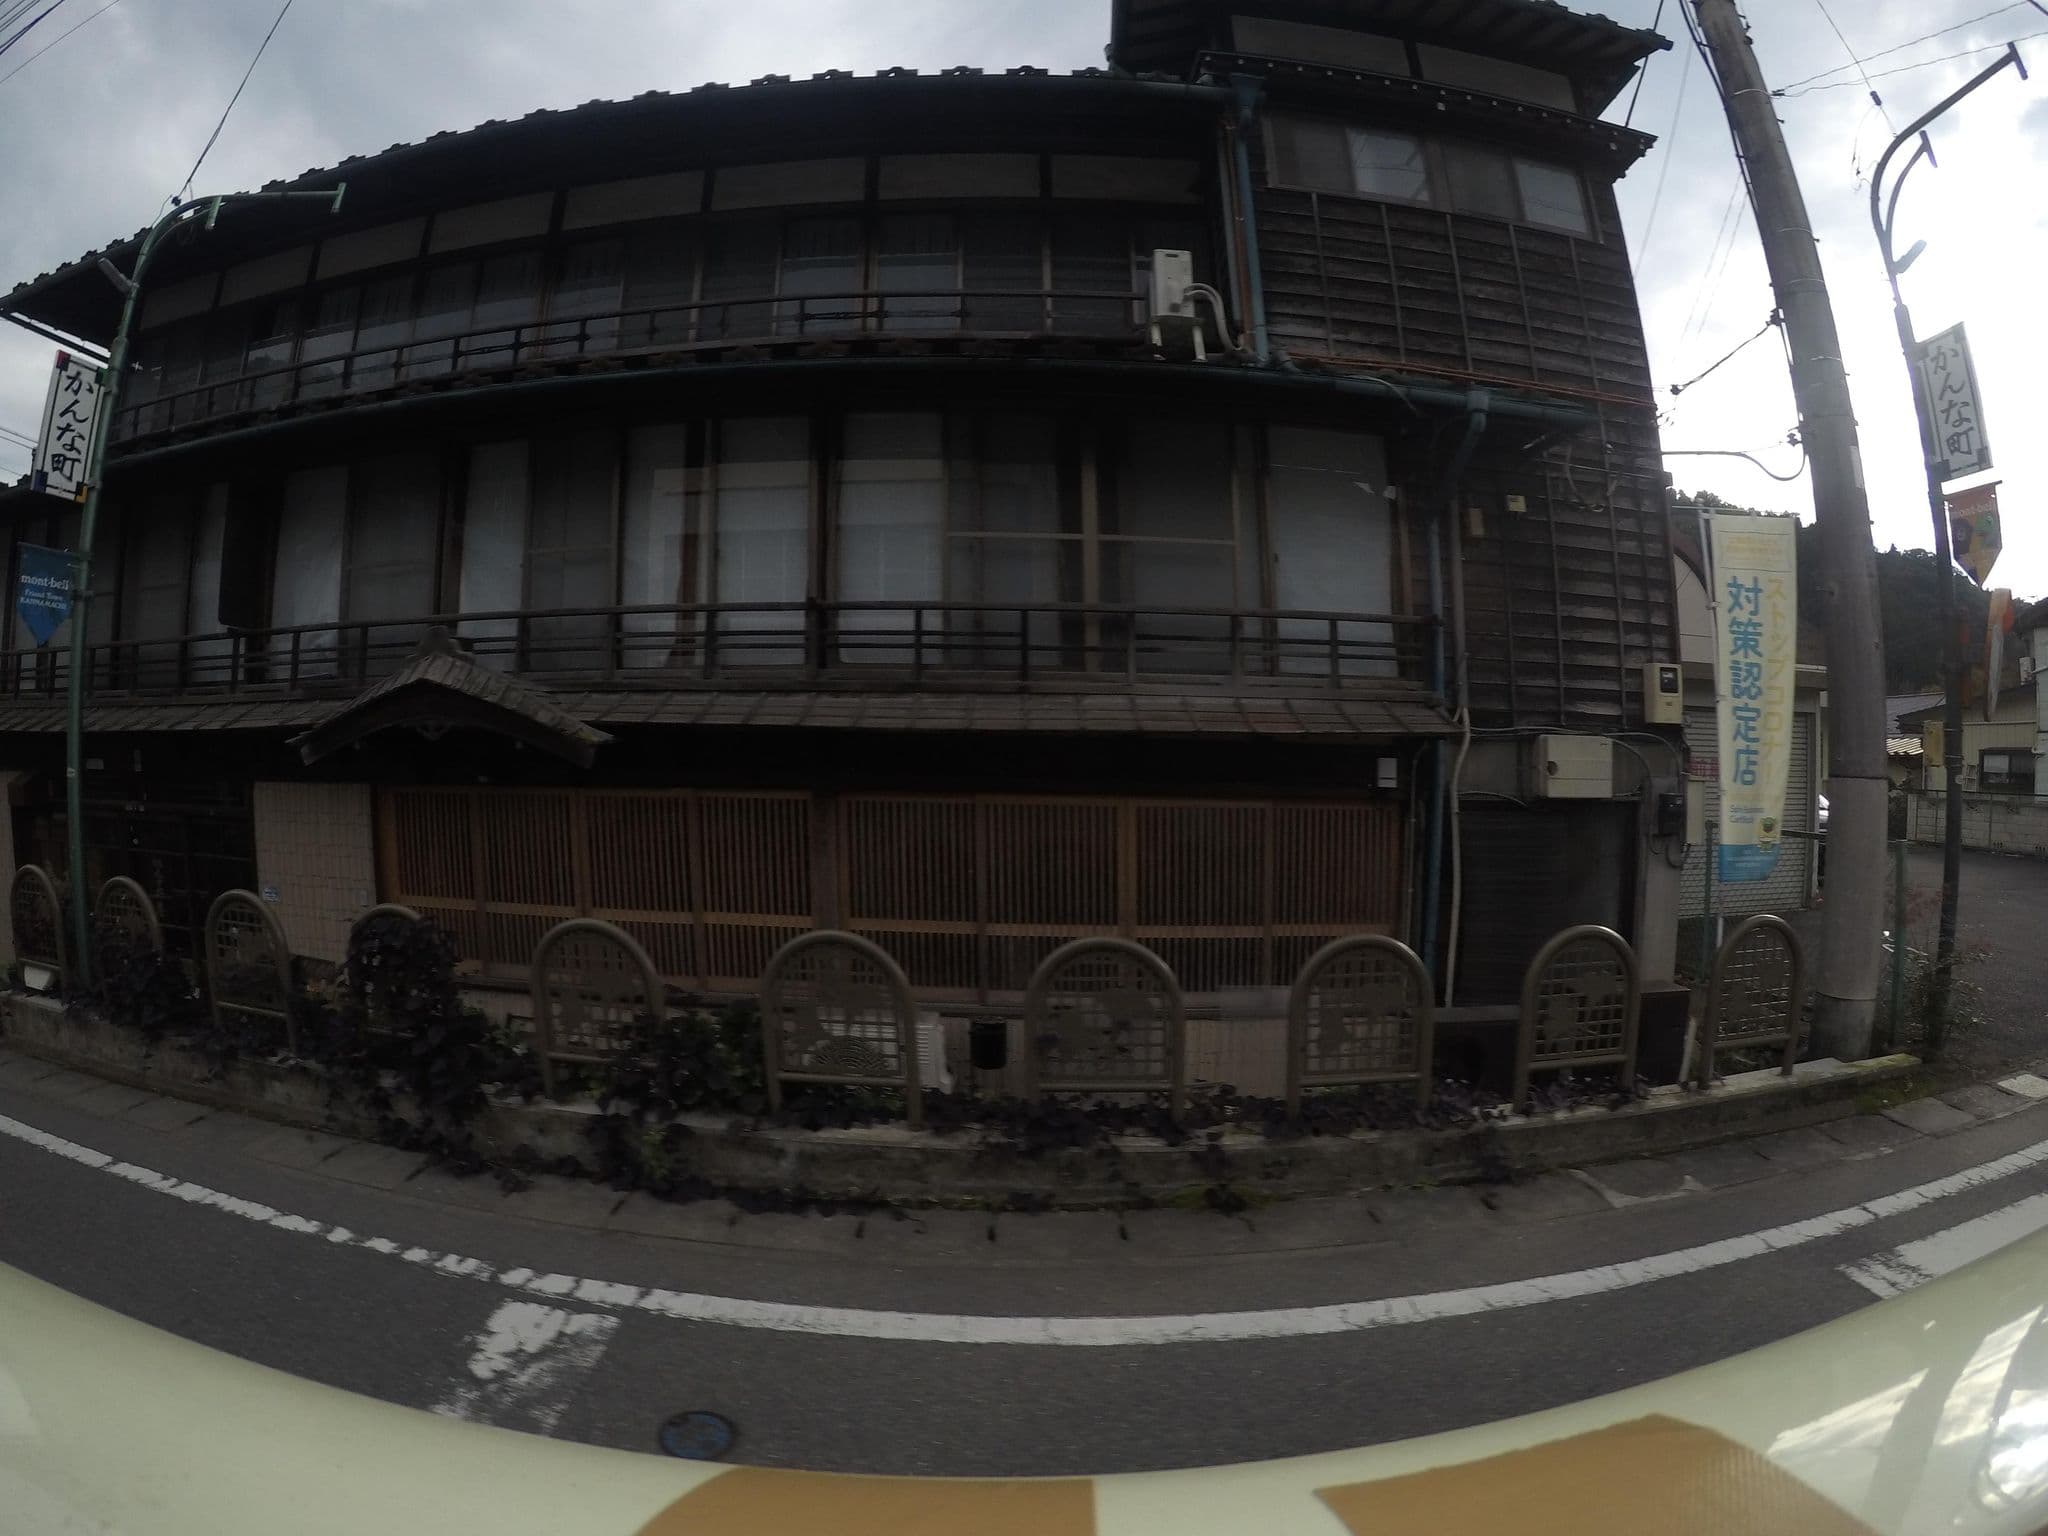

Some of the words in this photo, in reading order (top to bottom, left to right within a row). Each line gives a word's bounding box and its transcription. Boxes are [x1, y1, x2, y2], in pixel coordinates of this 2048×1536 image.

[51, 370, 94, 482] かんな町
[1930, 345, 1974, 456] かんな町
[1726, 575, 1764, 786] 対策認定店
